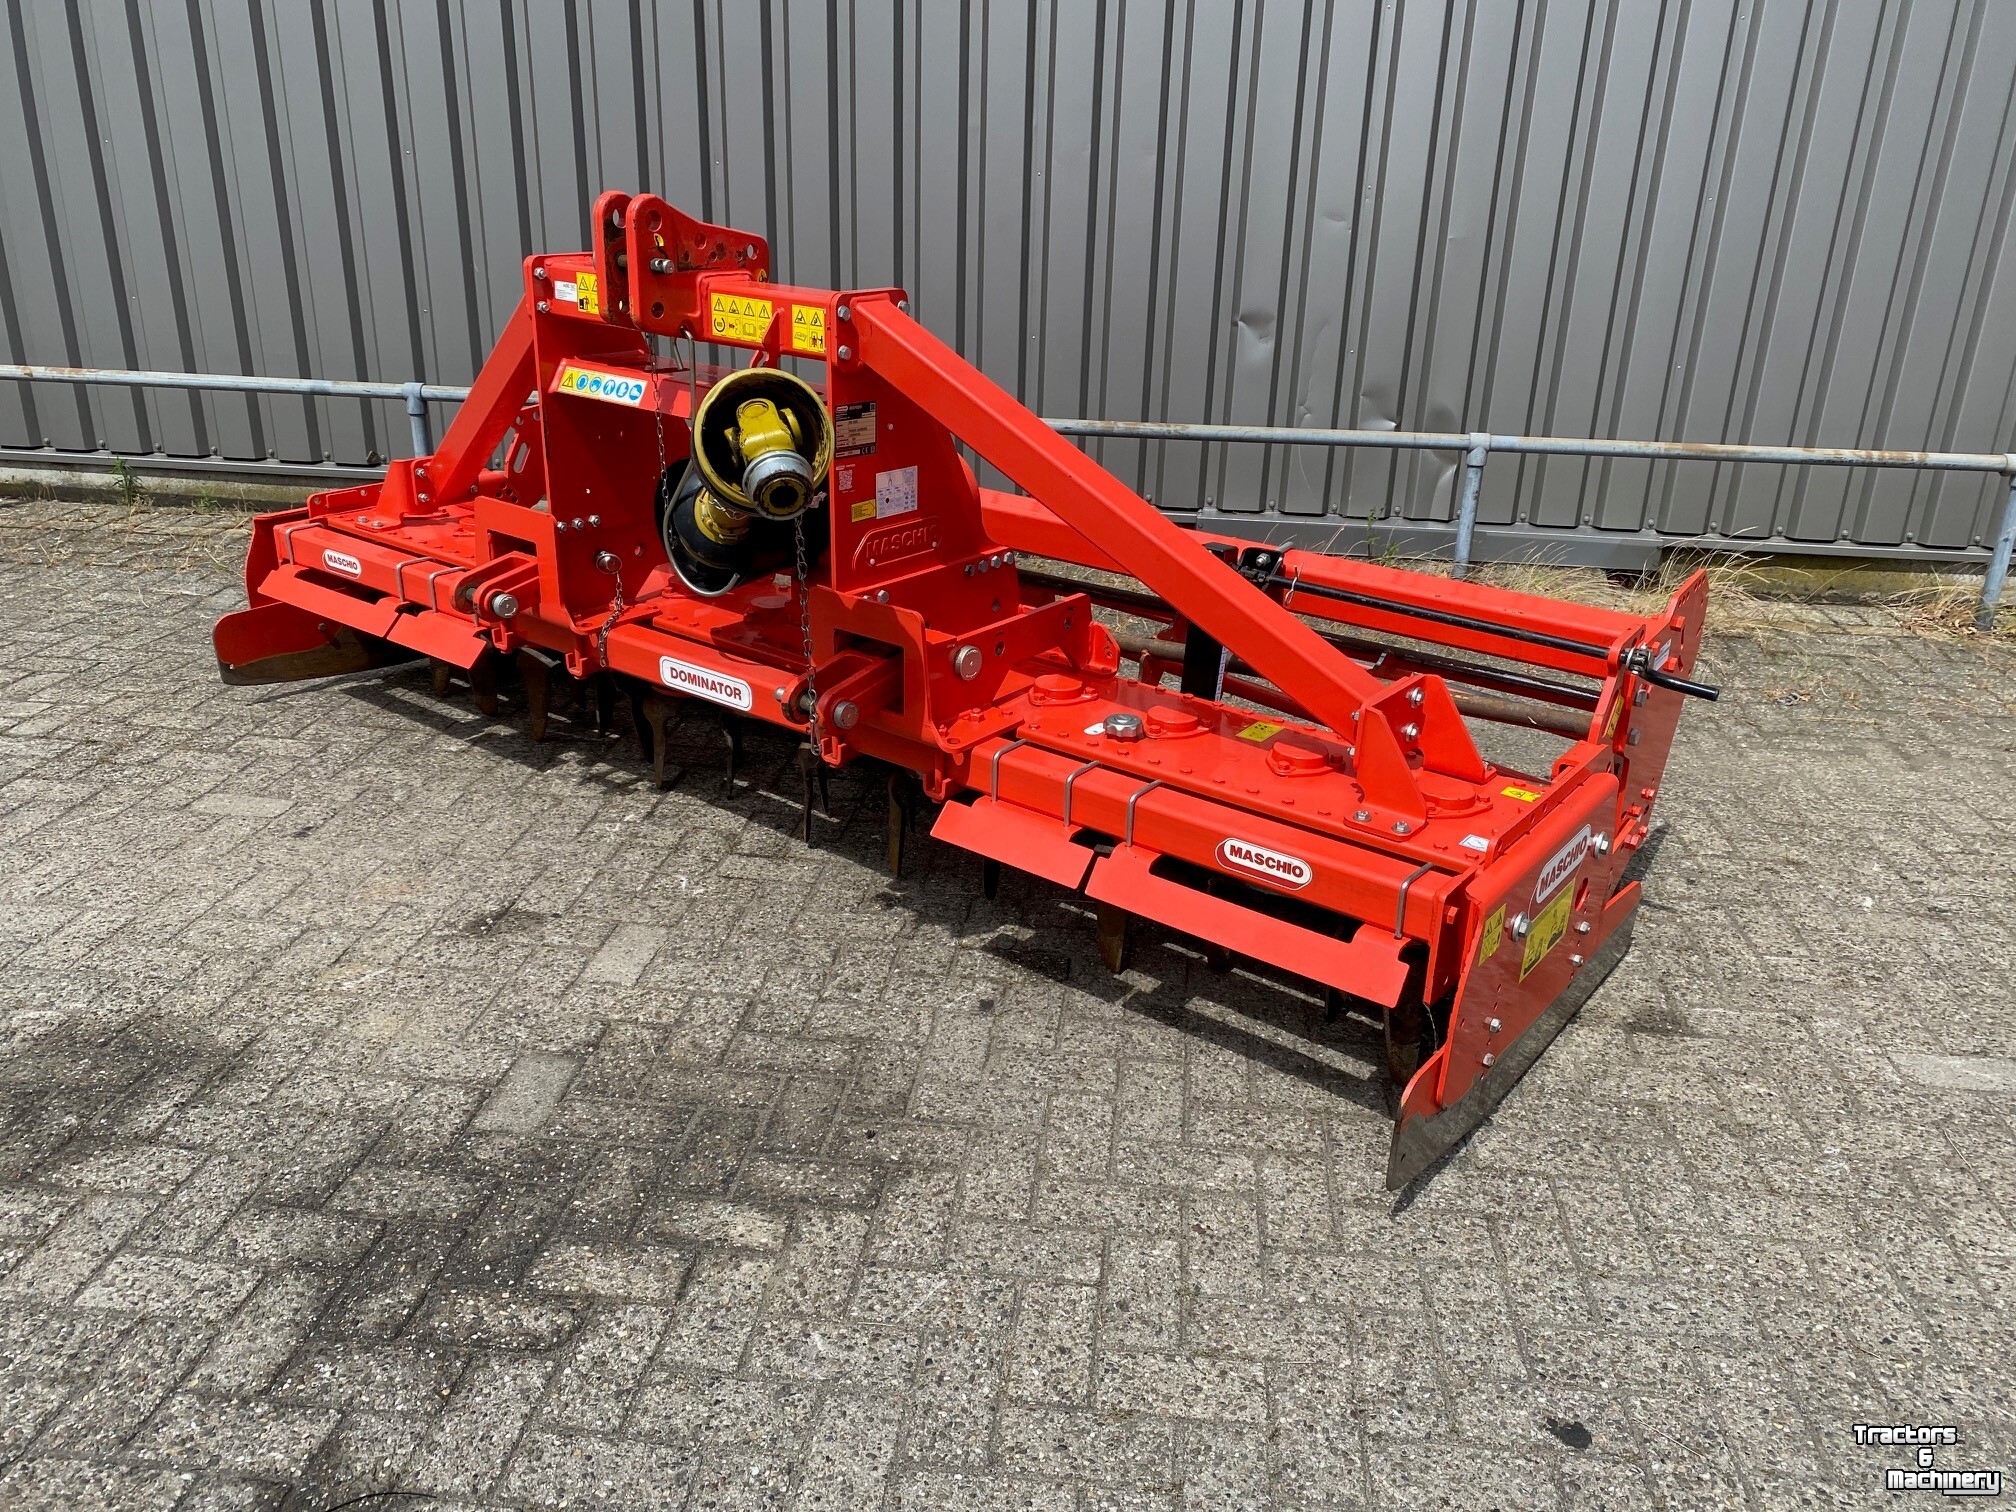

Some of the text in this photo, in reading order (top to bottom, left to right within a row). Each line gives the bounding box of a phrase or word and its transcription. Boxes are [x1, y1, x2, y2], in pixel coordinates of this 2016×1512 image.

[327, 554, 358, 570] MASCHIO
[669, 666, 742, 701] DOMINATOR
[1229, 844, 1304, 878] MASCHIO
[1538, 834, 1588, 897] MASCHIO
